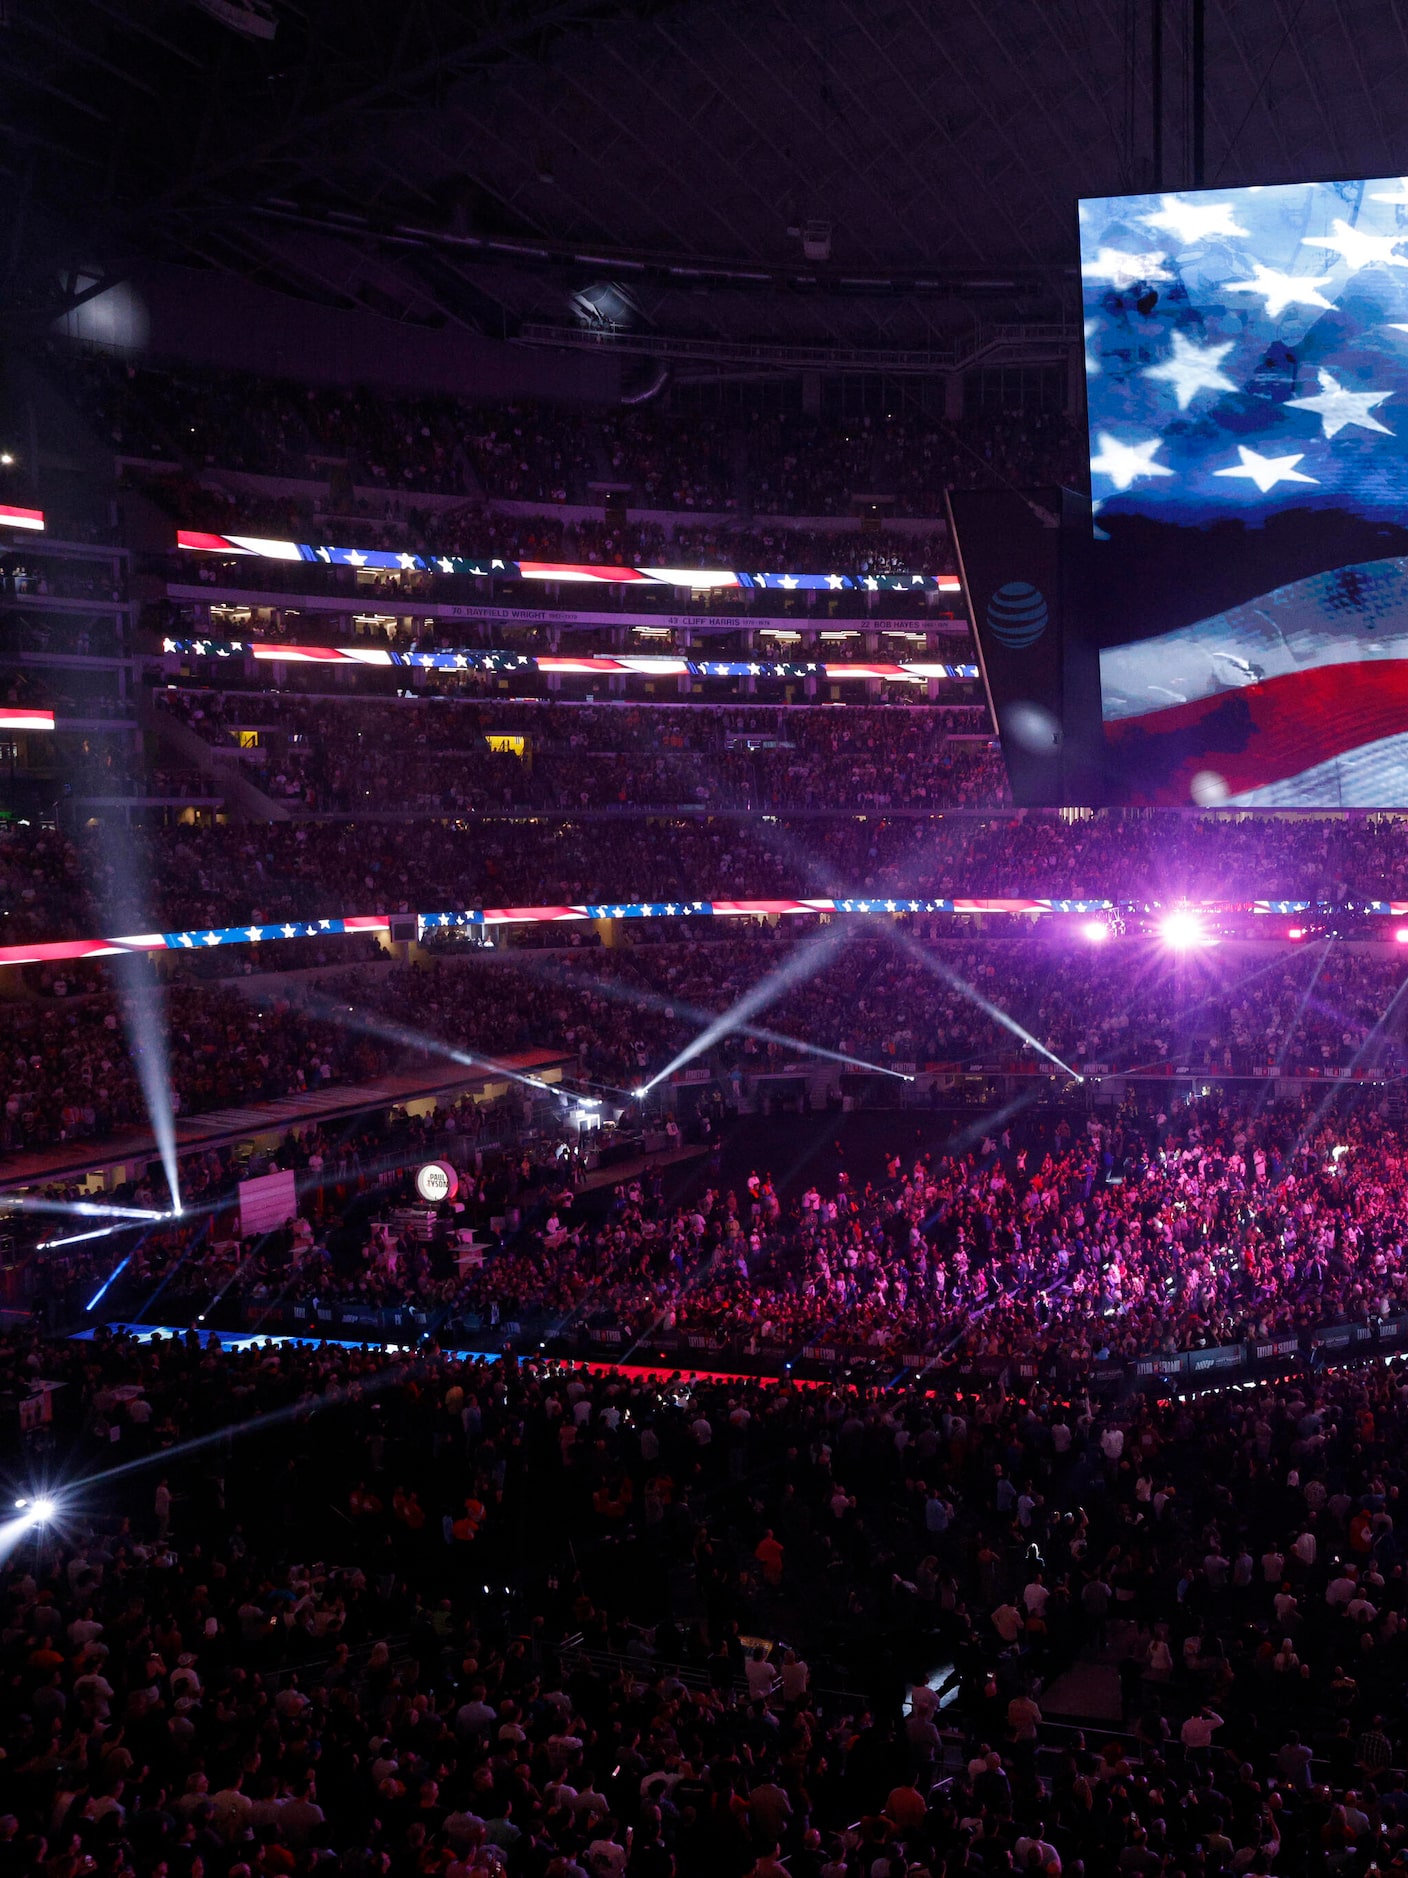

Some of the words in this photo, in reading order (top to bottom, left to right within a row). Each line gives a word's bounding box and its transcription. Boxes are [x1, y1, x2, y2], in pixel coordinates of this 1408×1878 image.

[453, 607, 461, 615] 70
[467, 607, 508, 617] RAYFIELD
[511, 610, 545, 619] WRIGHT
[430, 1173, 445, 1181] PAUL
